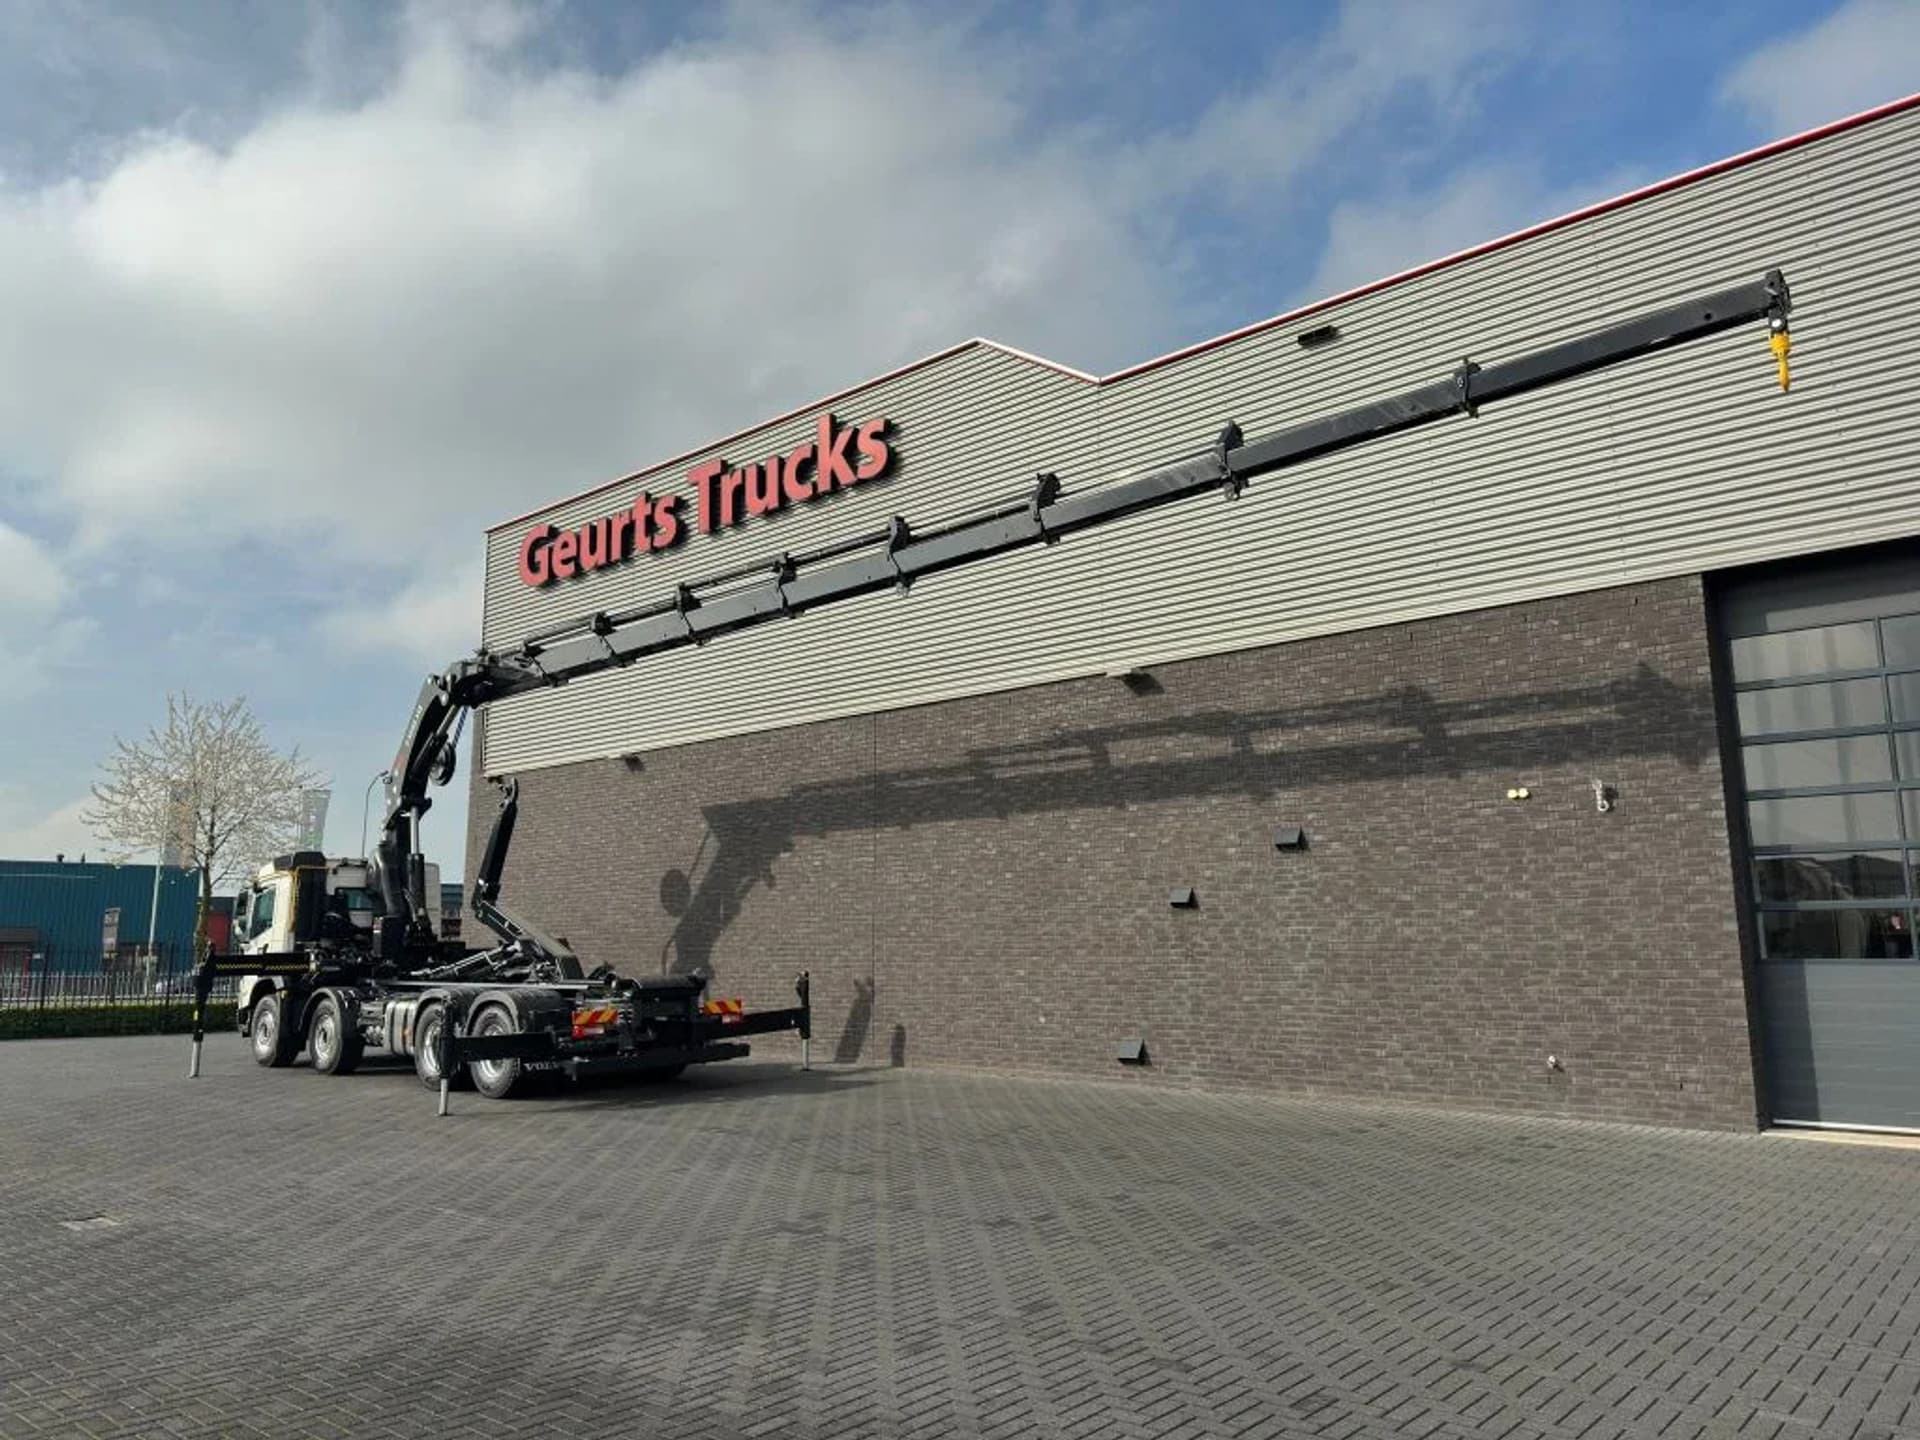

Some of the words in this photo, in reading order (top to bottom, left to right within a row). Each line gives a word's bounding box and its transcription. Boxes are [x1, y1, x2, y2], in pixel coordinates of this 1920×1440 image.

[518, 491, 679, 587] Geurts
[687, 413, 890, 533] Trucks
[523, 1061, 560, 1072] VOLV
